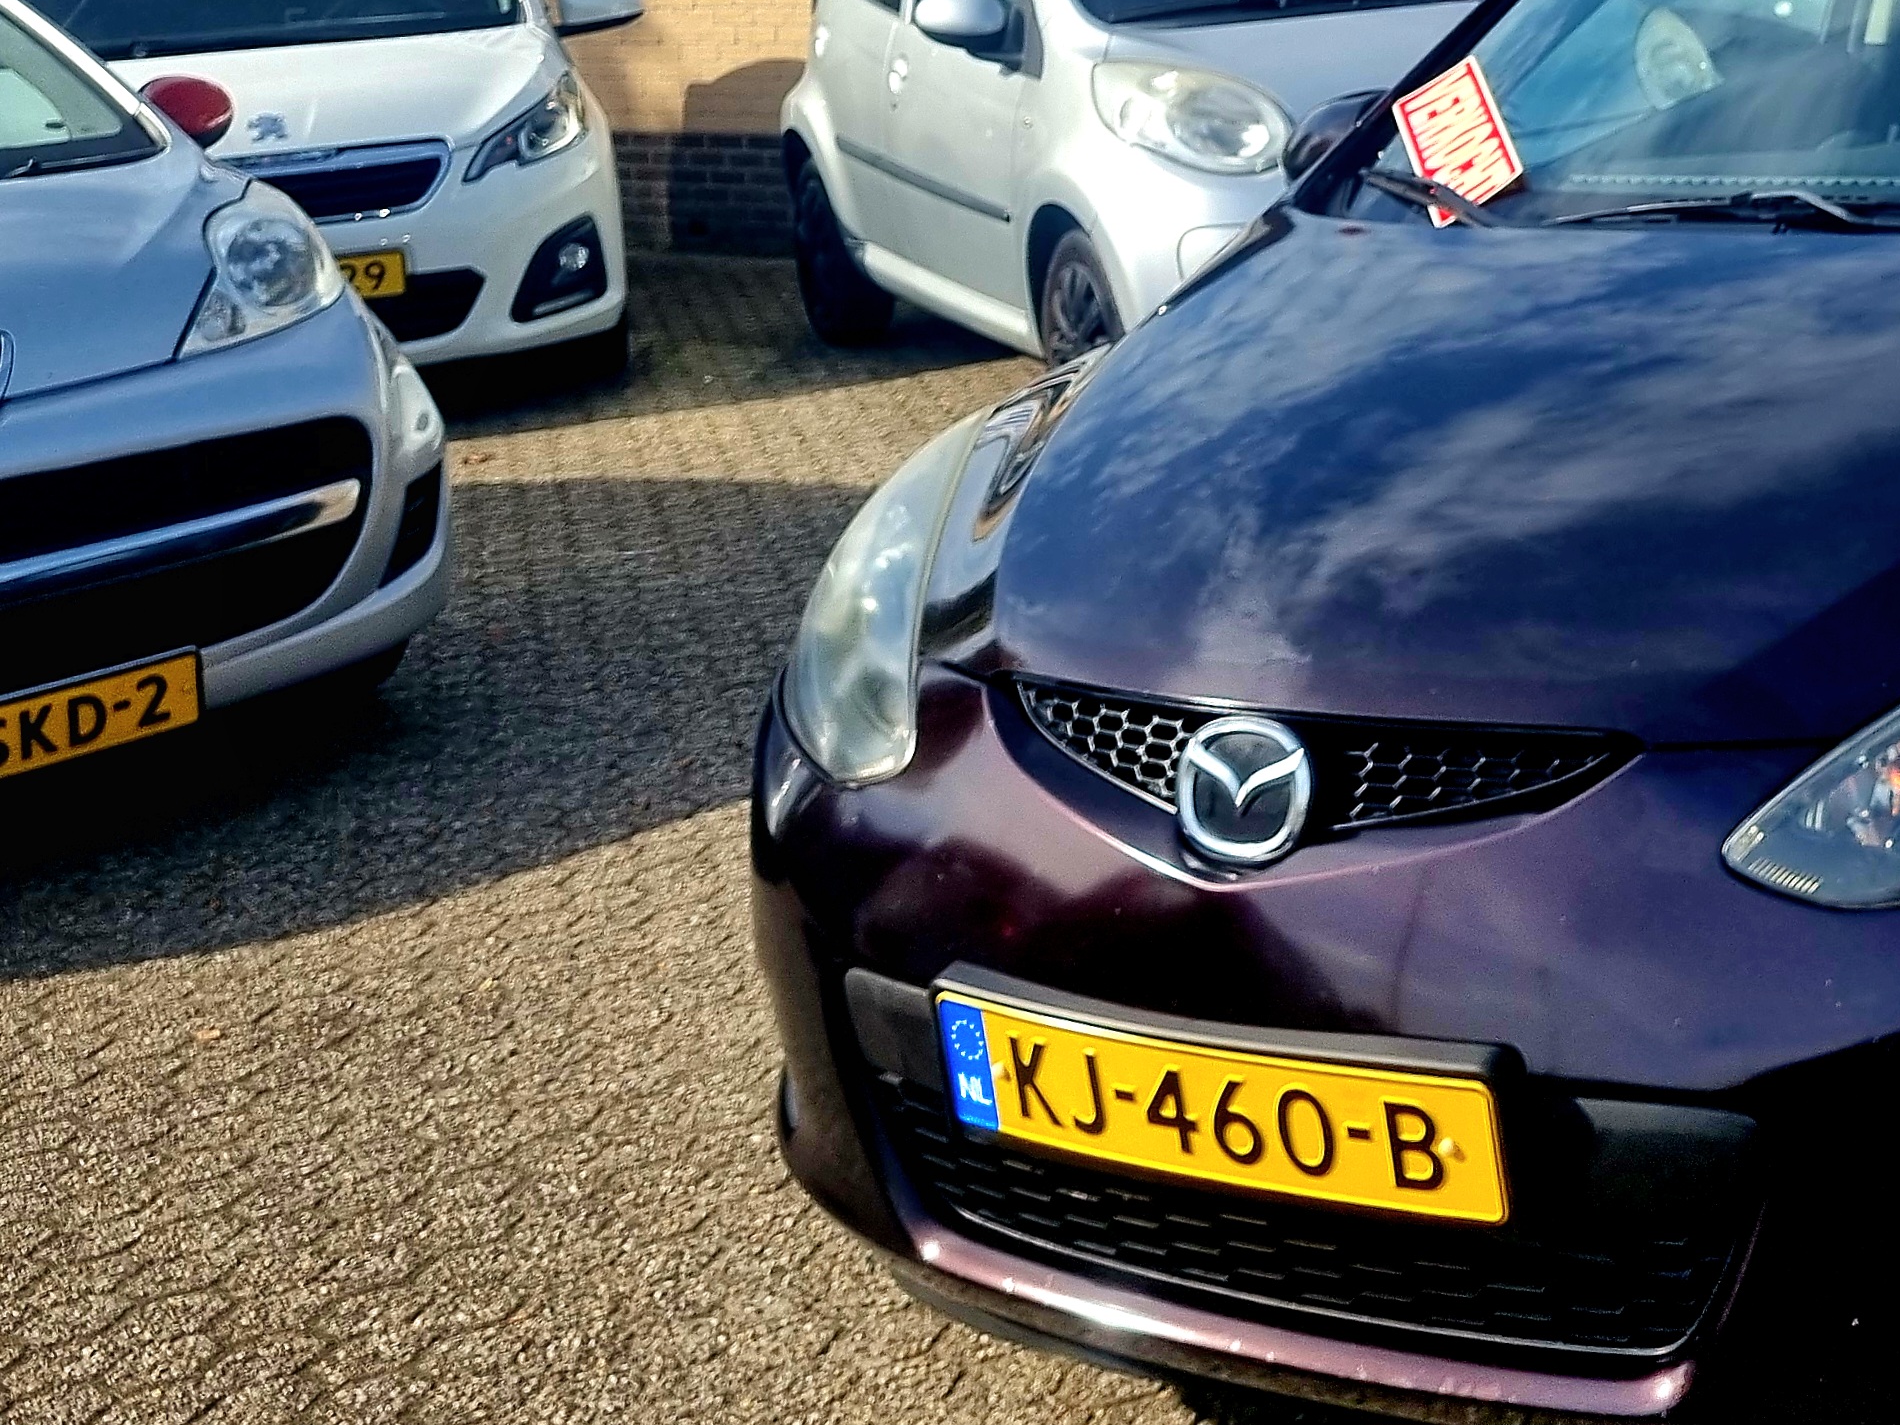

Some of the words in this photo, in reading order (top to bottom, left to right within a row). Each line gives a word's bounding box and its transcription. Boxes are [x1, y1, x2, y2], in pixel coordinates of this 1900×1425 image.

[1403, 64, 1515, 205] VERKOCHT
[957, 1072, 993, 1106] NL
[1006, 1031, 1447, 1191] KJ-460-B
